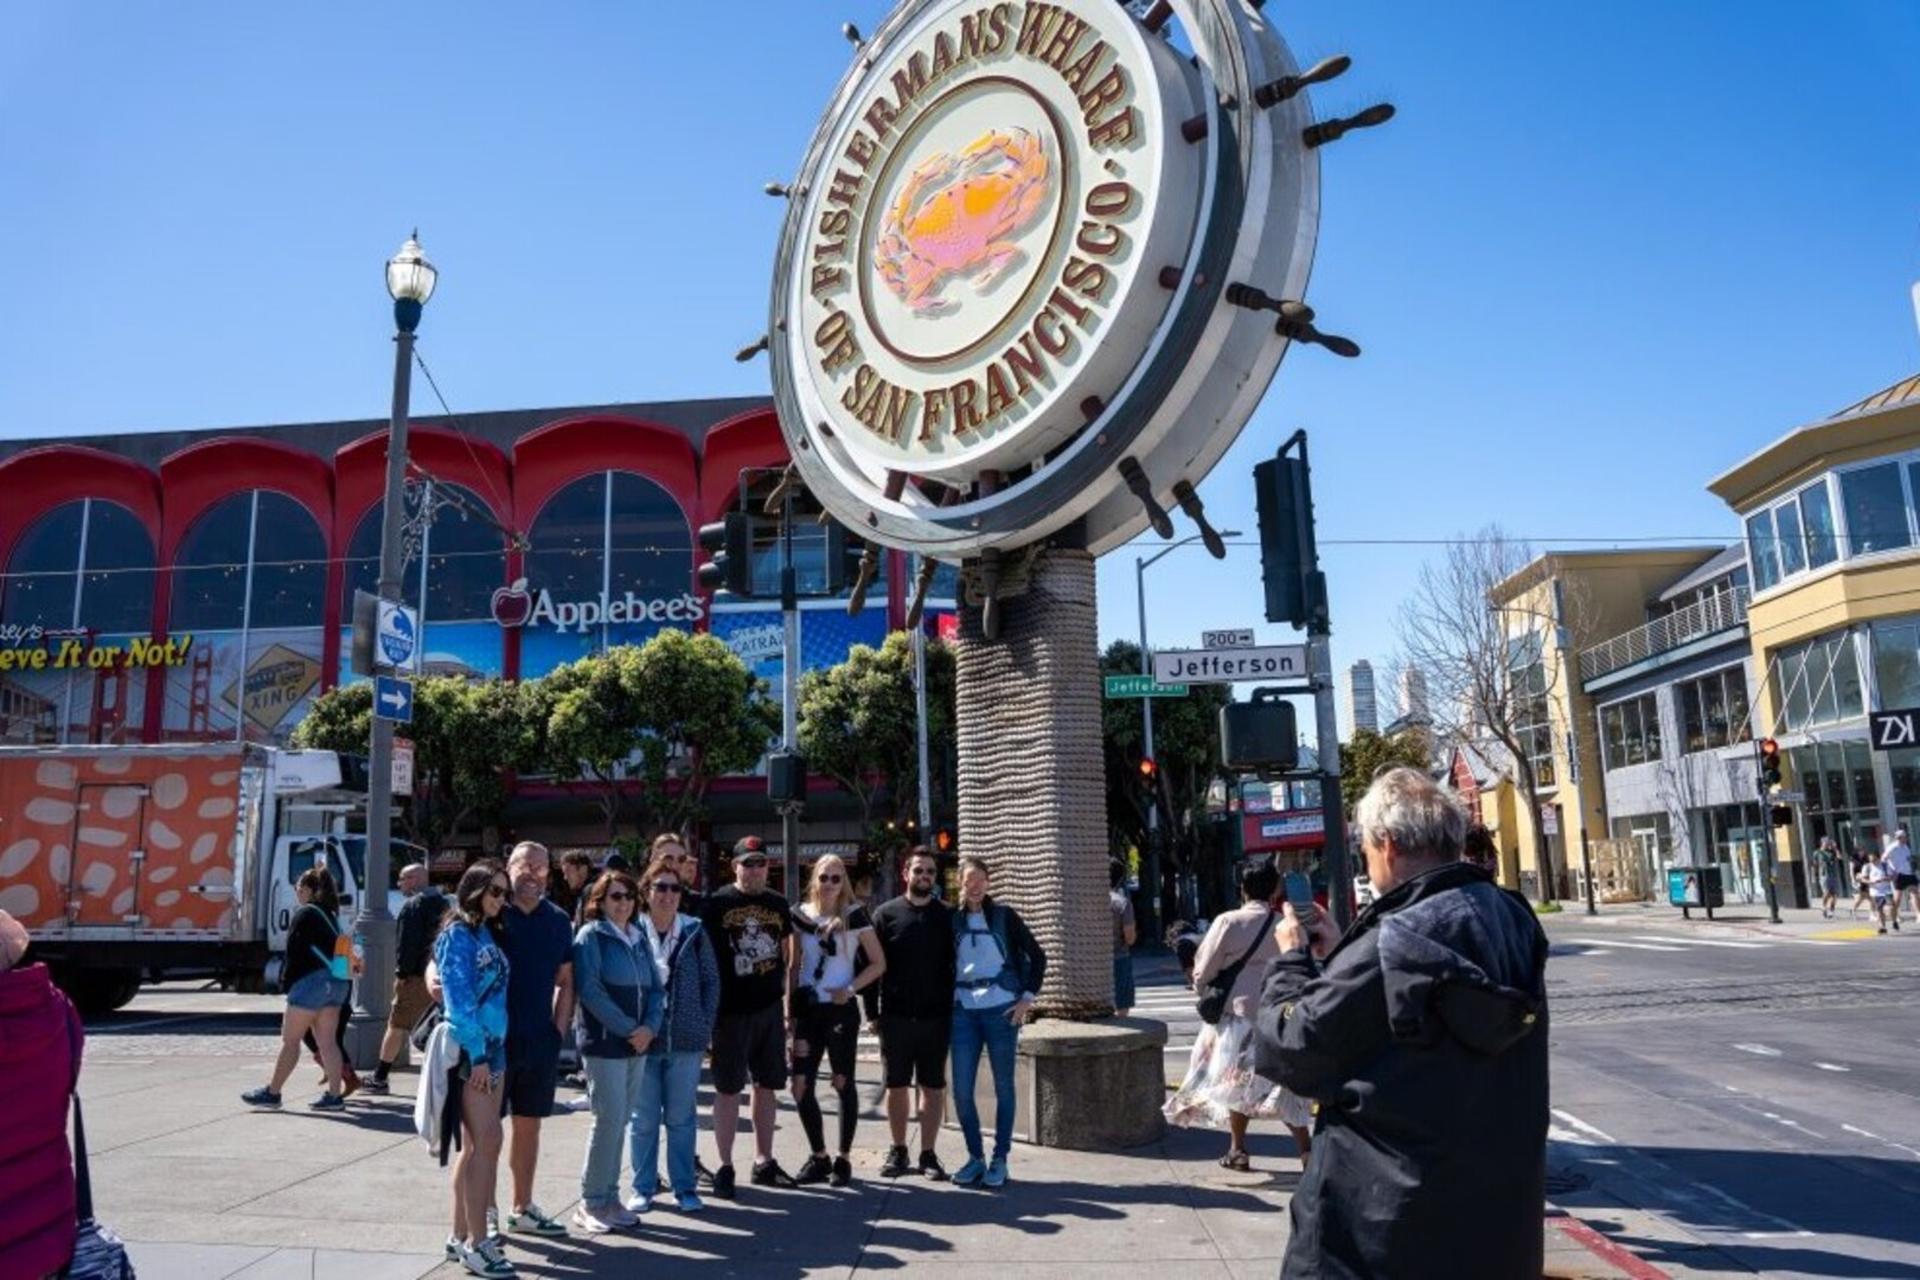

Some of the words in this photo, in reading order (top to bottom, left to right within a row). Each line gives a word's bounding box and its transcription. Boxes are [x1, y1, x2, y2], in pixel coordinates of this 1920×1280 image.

[1016, 1, 1136, 149] WHARF
[814, 309, 856, 373] OF
[841, 363, 916, 440] SAN
[918, 181, 1132, 442] FRANCISCO
[527, 588, 706, 633] Applebee's
[54, 639, 82, 668] It
[88, 645, 121, 668] or
[125, 634, 192, 668] Not!
[1207, 633, 1237, 647] 200
[1169, 656, 1293, 677] Jefferson
[252, 685, 297, 711] XING
